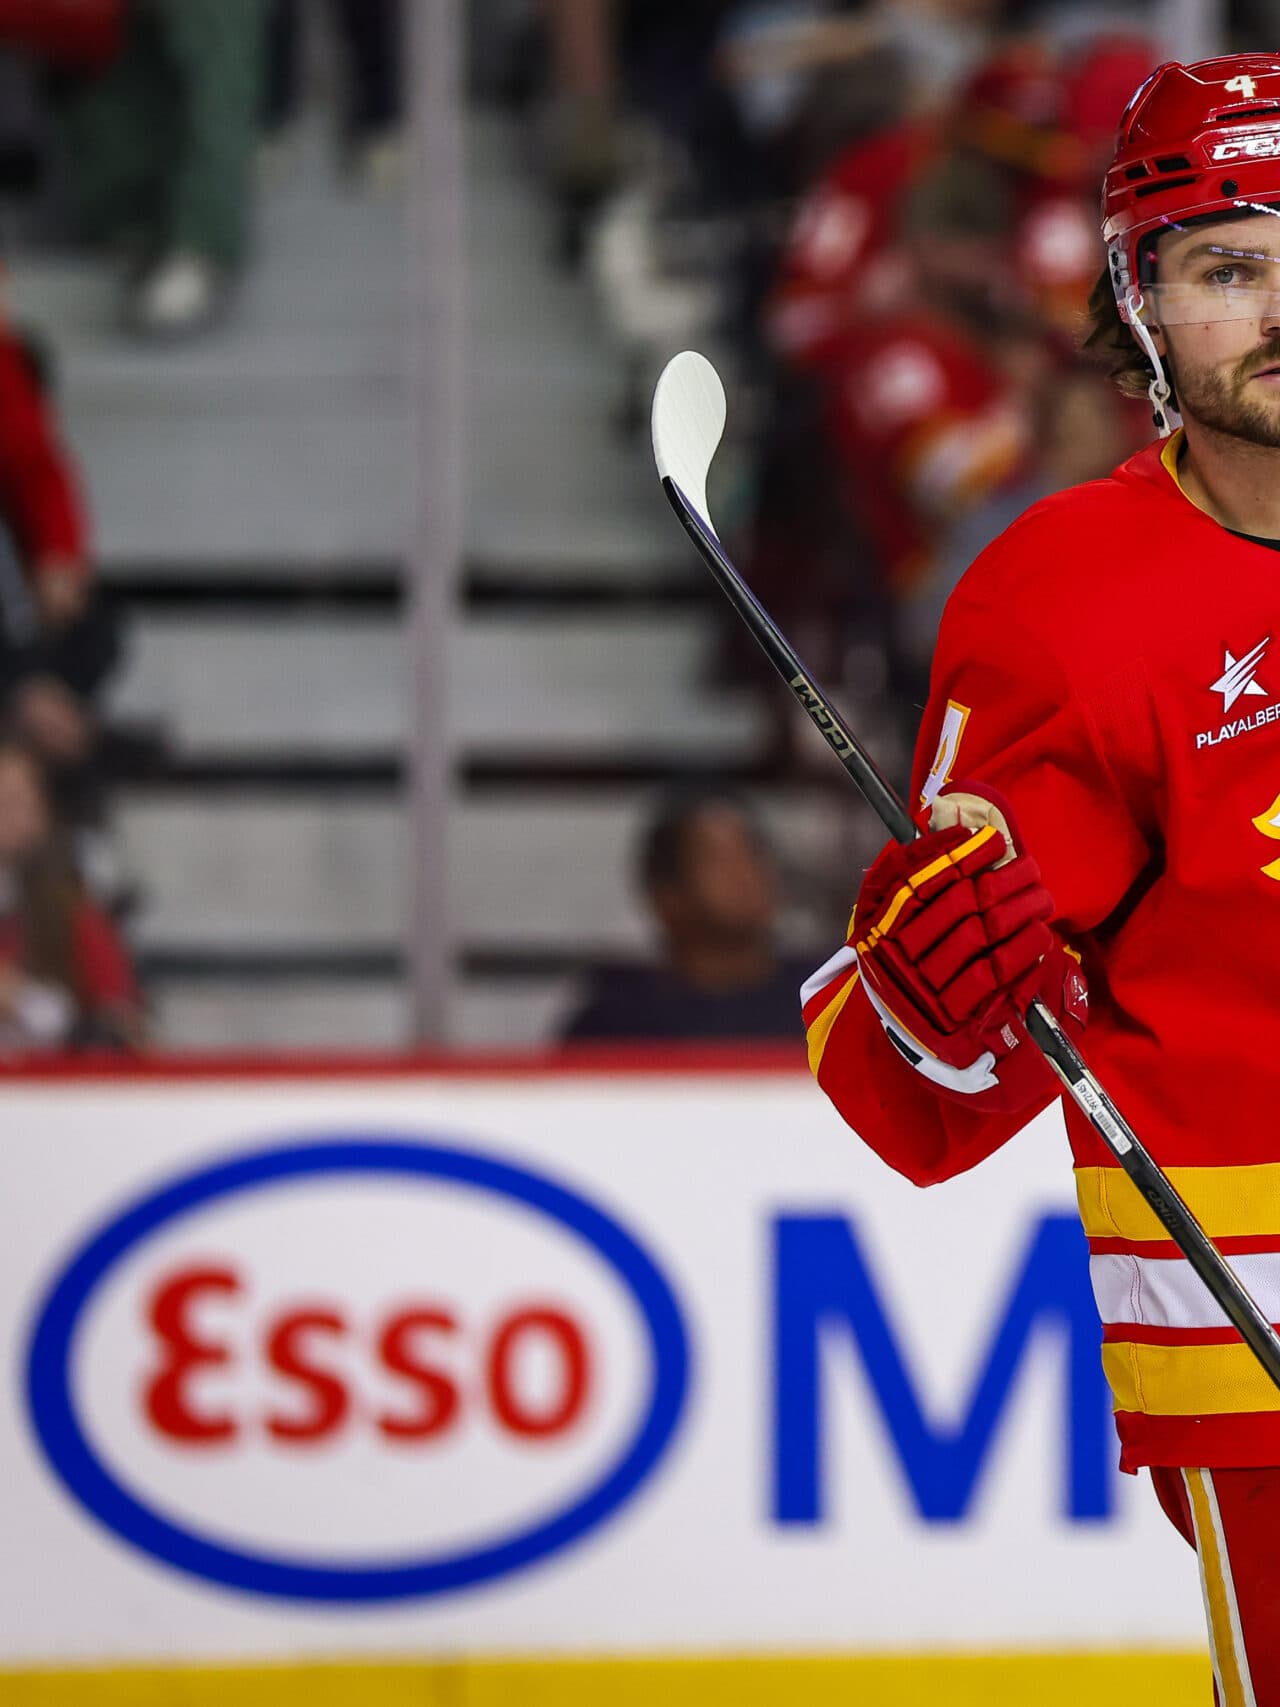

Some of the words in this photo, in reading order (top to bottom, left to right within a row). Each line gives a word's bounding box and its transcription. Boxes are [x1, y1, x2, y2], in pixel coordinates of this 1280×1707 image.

[1224, 74, 1257, 98] 4
[792, 683, 850, 752] CCM
[142, 1260, 594, 1448] Esso
